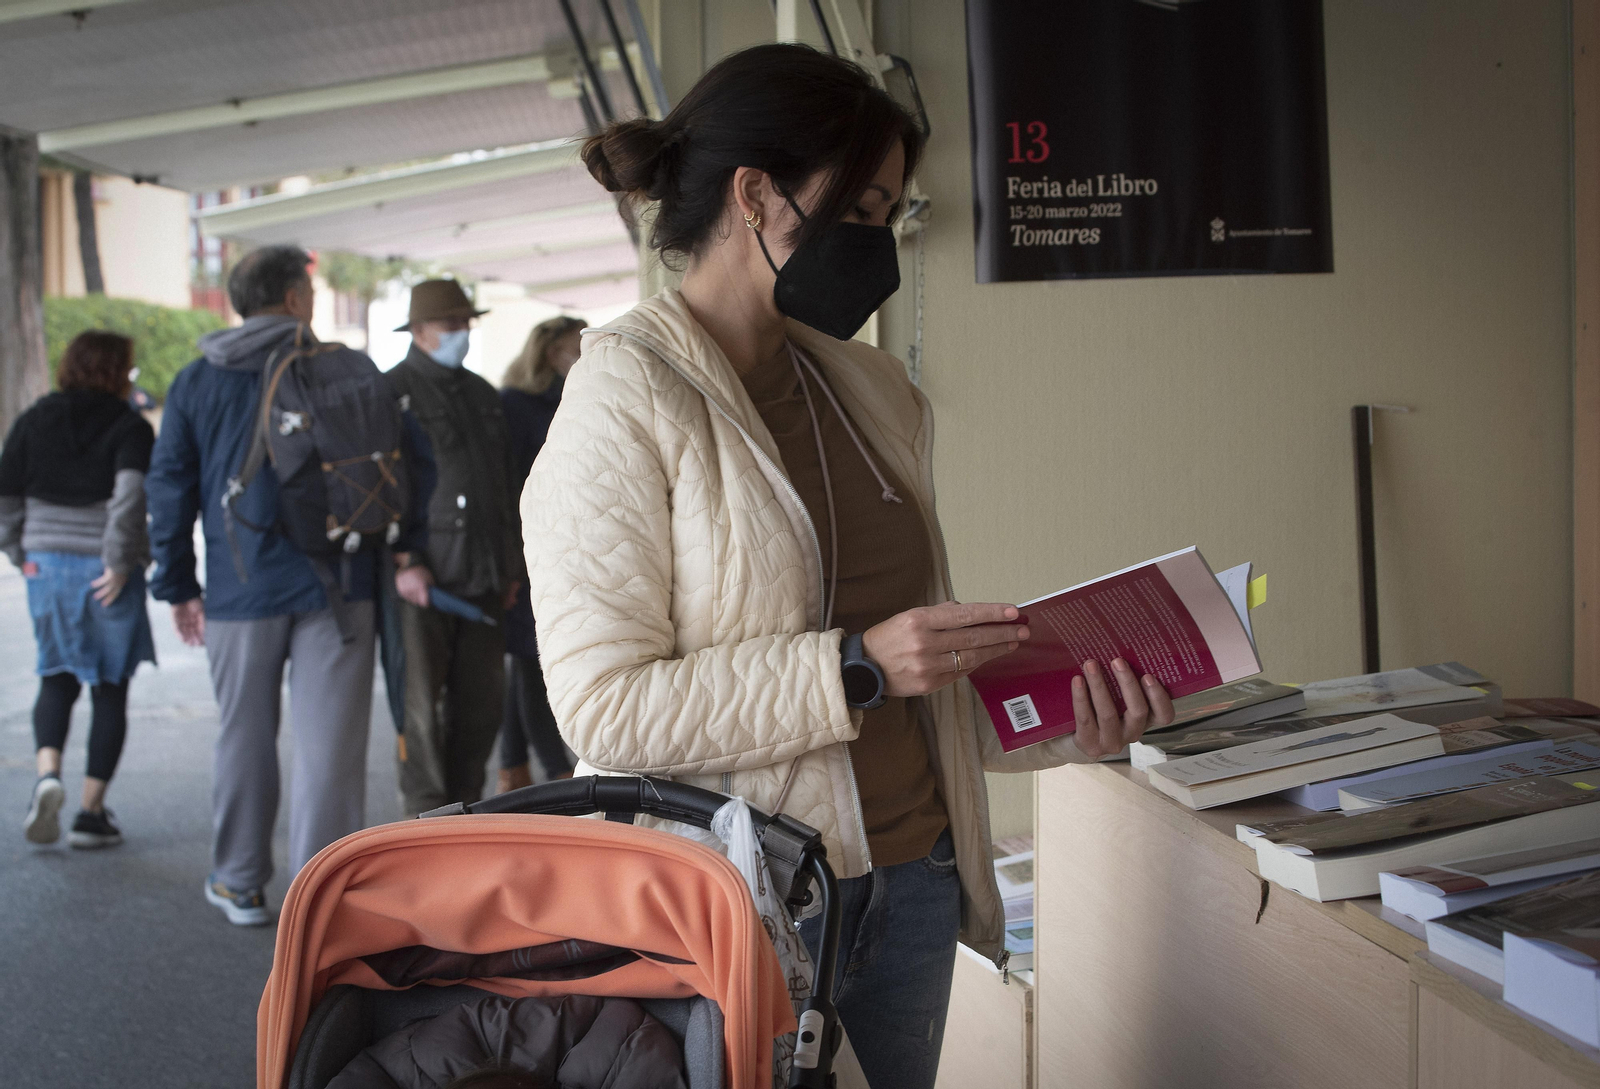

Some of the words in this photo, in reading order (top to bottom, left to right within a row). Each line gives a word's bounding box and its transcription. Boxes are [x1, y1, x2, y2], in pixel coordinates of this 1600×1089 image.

[1006, 121, 1050, 164] 13
[1007, 176, 1062, 199] Feria
[1066, 178, 1092, 198] del
[1097, 173, 1158, 197] Libro
[1010, 205, 1042, 219] 15-20
[1045, 205, 1088, 218] marzo
[1090, 203, 1122, 217] 2022
[1010, 222, 1101, 247] Tomares
